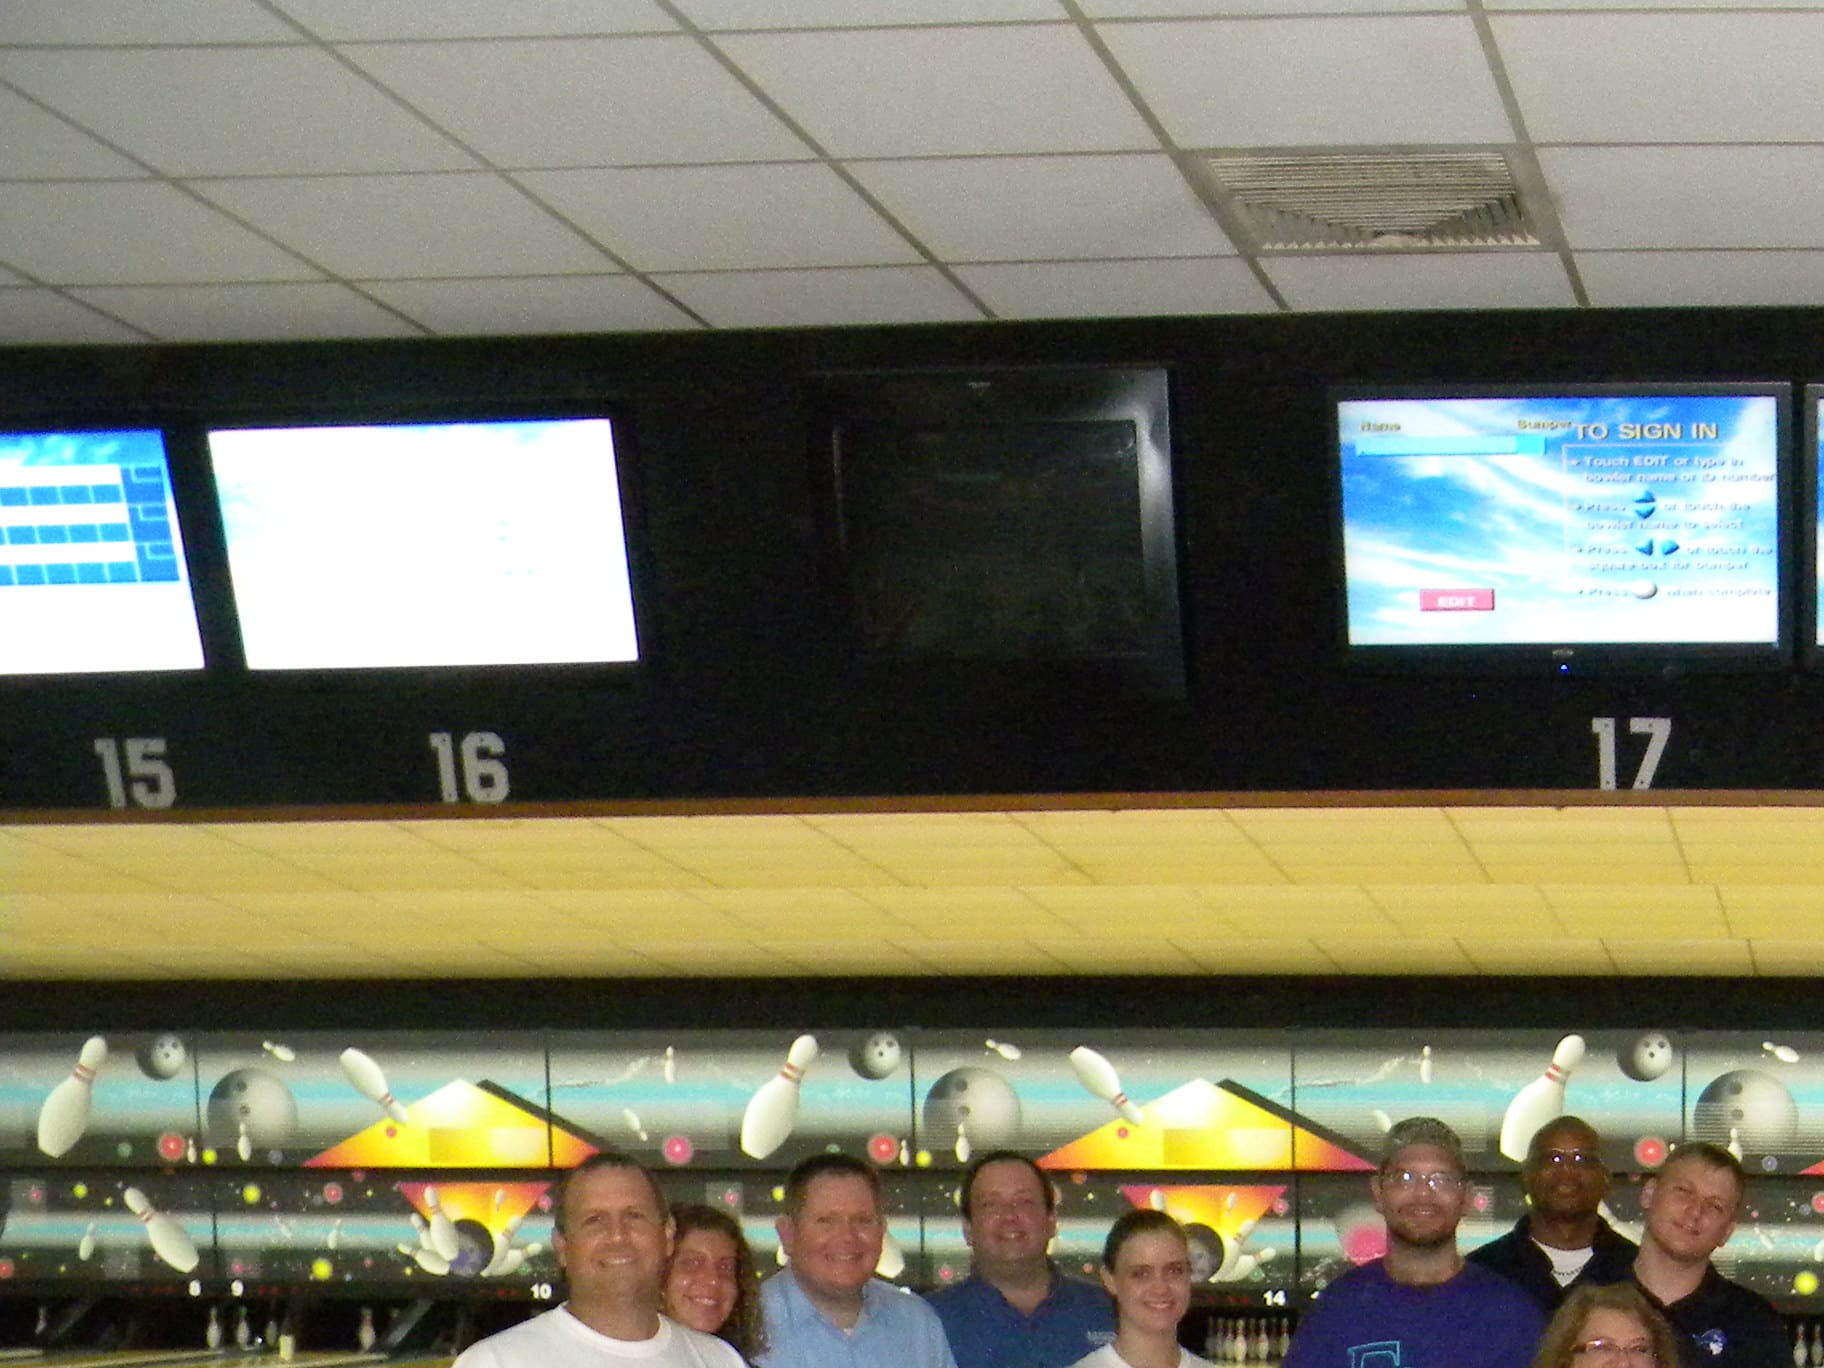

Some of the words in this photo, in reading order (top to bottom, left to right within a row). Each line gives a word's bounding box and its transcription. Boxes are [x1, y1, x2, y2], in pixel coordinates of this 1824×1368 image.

[1517, 419, 1572, 431] Bumper
[1576, 423, 1609, 440] TO
[1619, 423, 1684, 440] SIGN
[1691, 423, 1719, 440] IN
[1584, 456, 1629, 467] Touch
[1633, 455, 1669, 467] EDIT
[1591, 716, 1672, 790] 17
[94, 737, 178, 809] 15
[428, 732, 511, 805] 16
[188, 1280, 202, 1297] 8
[231, 1280, 245, 1297] 9
[530, 1283, 553, 1300] 10
[1263, 1290, 1287, 1306] 14
